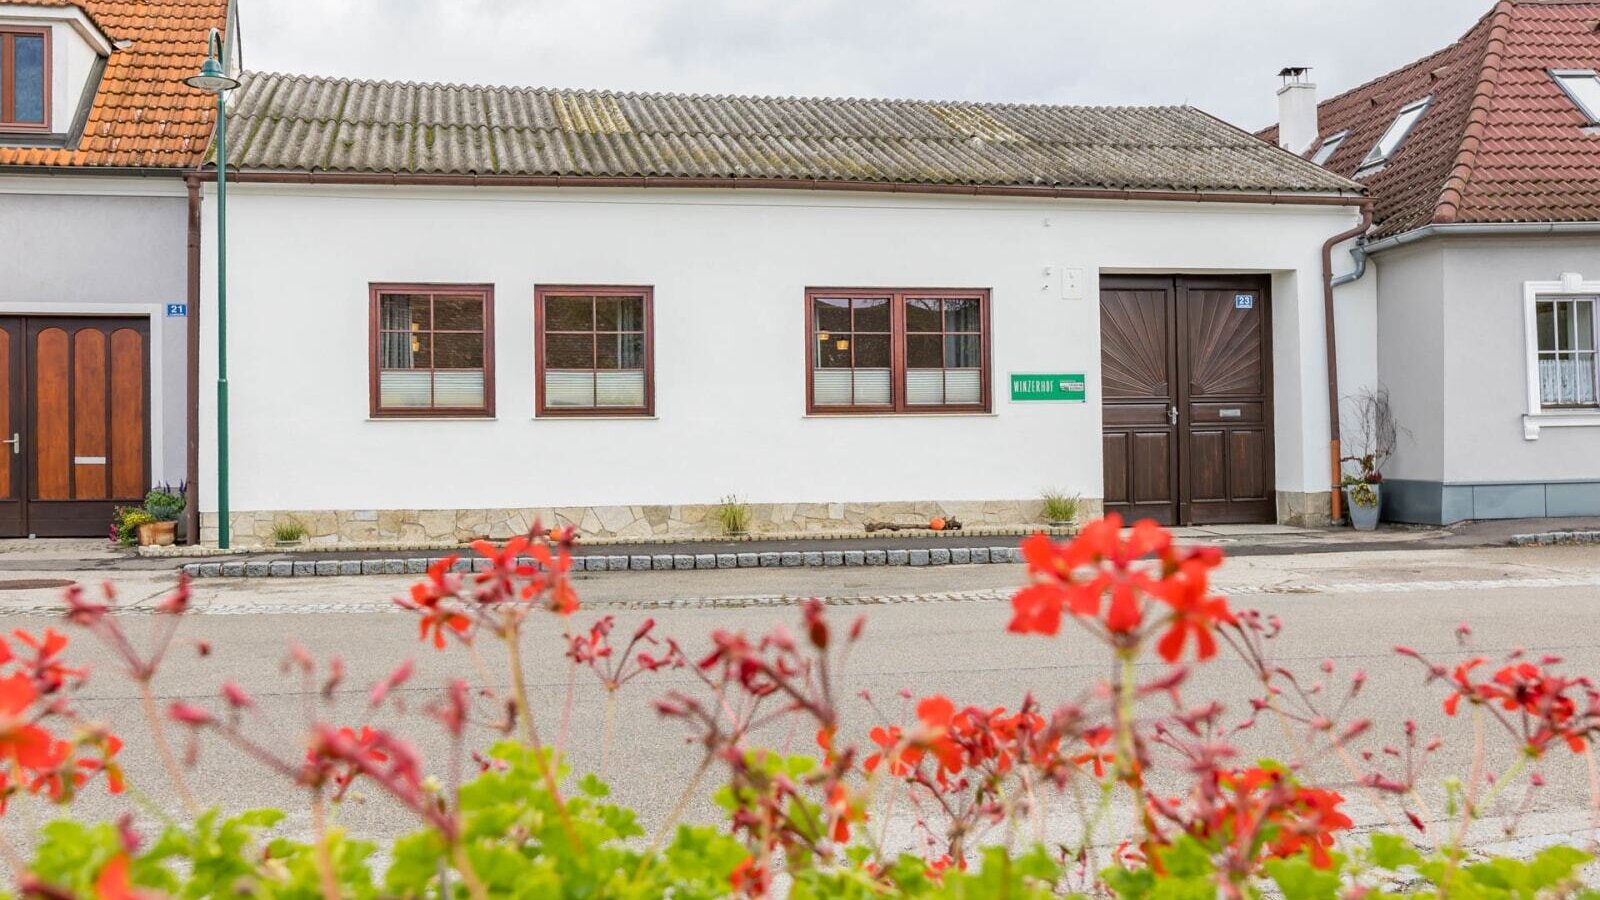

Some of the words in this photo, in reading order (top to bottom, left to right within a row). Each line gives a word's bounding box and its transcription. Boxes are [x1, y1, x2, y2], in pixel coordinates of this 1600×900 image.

[1239, 296, 1250, 305] 23
[171, 305, 183, 313] 21
[1013, 380, 1054, 393] WINZERHOF
